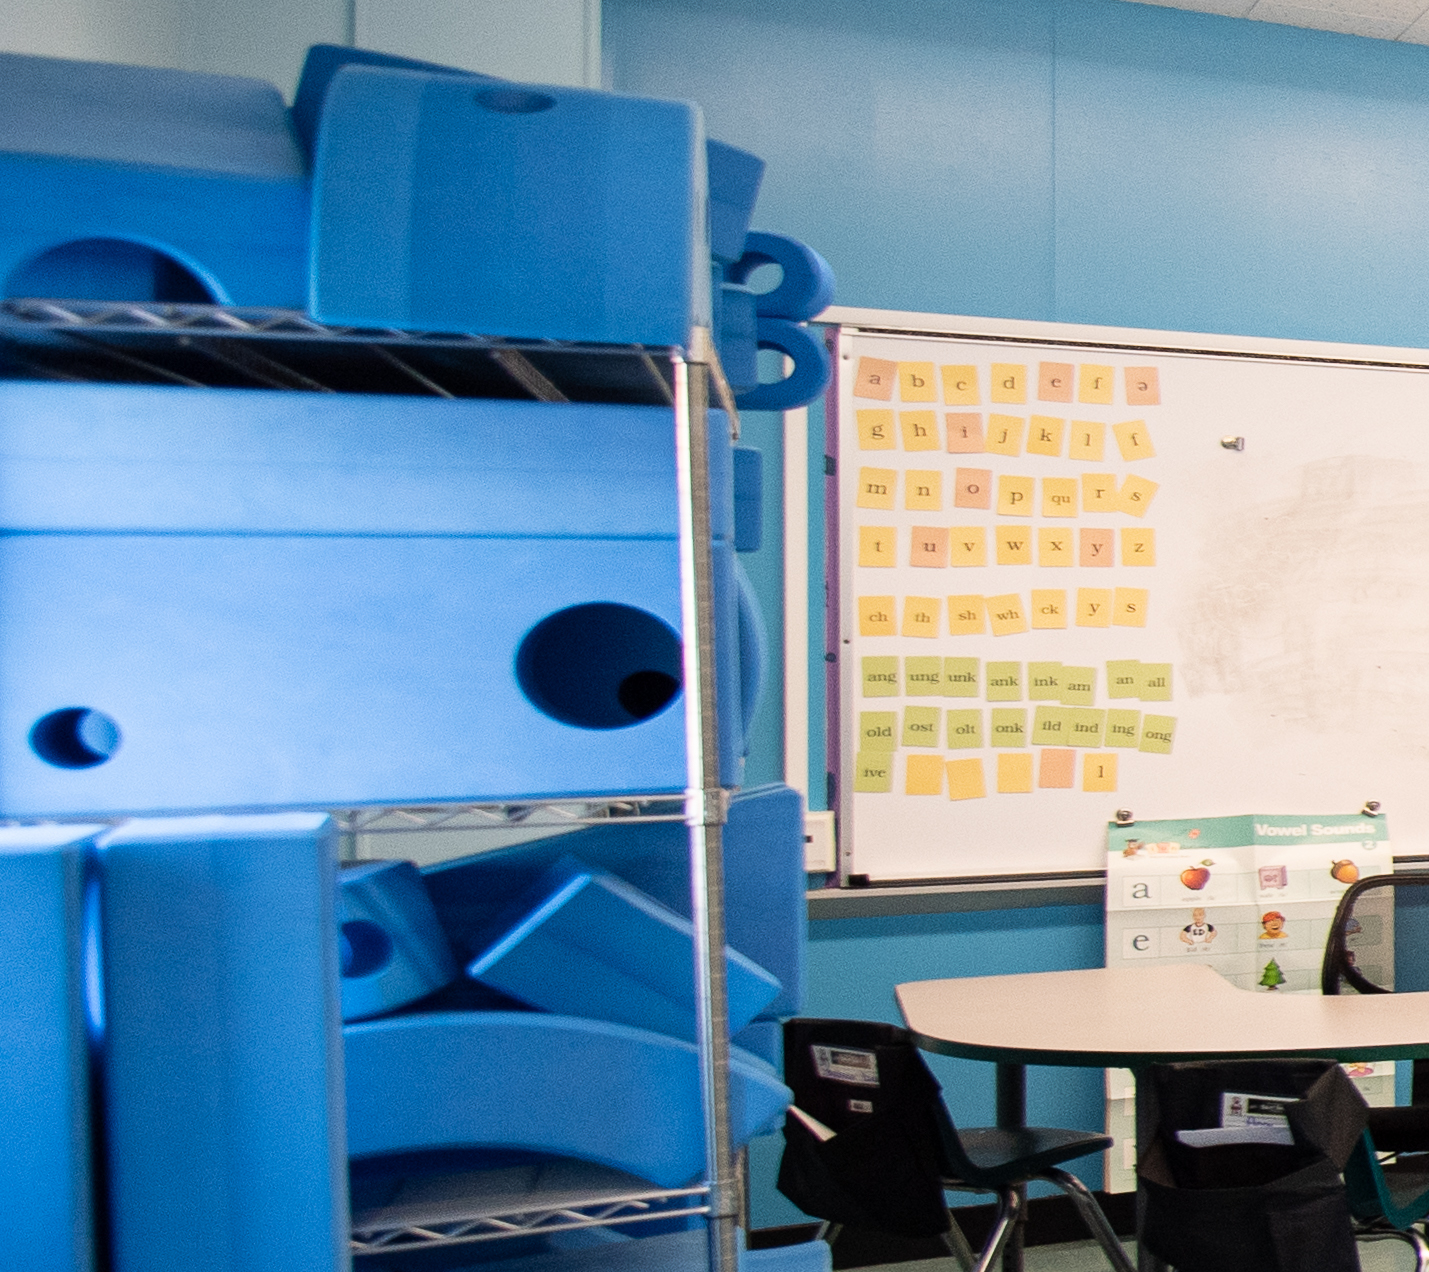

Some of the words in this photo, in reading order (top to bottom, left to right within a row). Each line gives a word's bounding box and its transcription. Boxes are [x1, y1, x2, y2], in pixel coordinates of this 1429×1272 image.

[869, 374, 881, 385] a
[911, 374, 925, 388] b
[955, 381, 966, 390] c
[1002, 376, 1015, 390] d
[1050, 376, 1062, 388] e
[1093, 376, 1103, 390] f
[871, 425, 885, 440] g
[913, 423, 927, 437] h
[961, 425, 969, 438] i
[998, 428, 1009, 444] j
[1040, 428, 1052, 442] k
[866, 483, 887, 495] m
[917, 486, 930, 497] n
[966, 484, 980, 494] o
[1010, 491, 1024, 505] p
[1051, 496, 1071, 506] qu
[1095, 488, 1105, 499] r
[1131, 491, 1141, 502] s
[874, 541, 882, 553] t
[923, 542, 937, 553] u
[963, 542, 975, 552] v
[1006, 541, 1023, 551] w
[1050, 541, 1062, 551] x
[1092, 542, 1103, 557] y
[1134, 542, 1144, 553] z
[869, 611, 888, 622] ch
[914, 611, 931, 624] th
[958, 609, 976, 621] sh
[996, 609, 1020, 621] wh
[1040, 603, 1059, 615] ck
[1088, 602, 1101, 617] y
[1126, 603, 1136, 613] s
[867, 672, 897, 684] ang
[909, 672, 940, 684] ung
[948, 672, 976, 683] unk
[990, 676, 1018, 687] ank
[1034, 676, 1059, 687] ink
[1067, 682, 1091, 692] am
[1115, 676, 1134, 685] an
[1147, 677, 1166, 688] all
[866, 726, 892, 737] old
[909, 722, 933, 733] ost
[955, 724, 976, 735] olt
[995, 723, 1023, 733] onk
[1074, 722, 1099, 734] ind
[1112, 724, 1135, 737] ing
[1145, 730, 1172, 743] ong
[864, 767, 887, 778] ive
[1254, 823, 1308, 837] Vowel
[1310, 822, 1376, 837] Sounds
[1132, 882, 1152, 899] a
[1132, 934, 1150, 952] e
